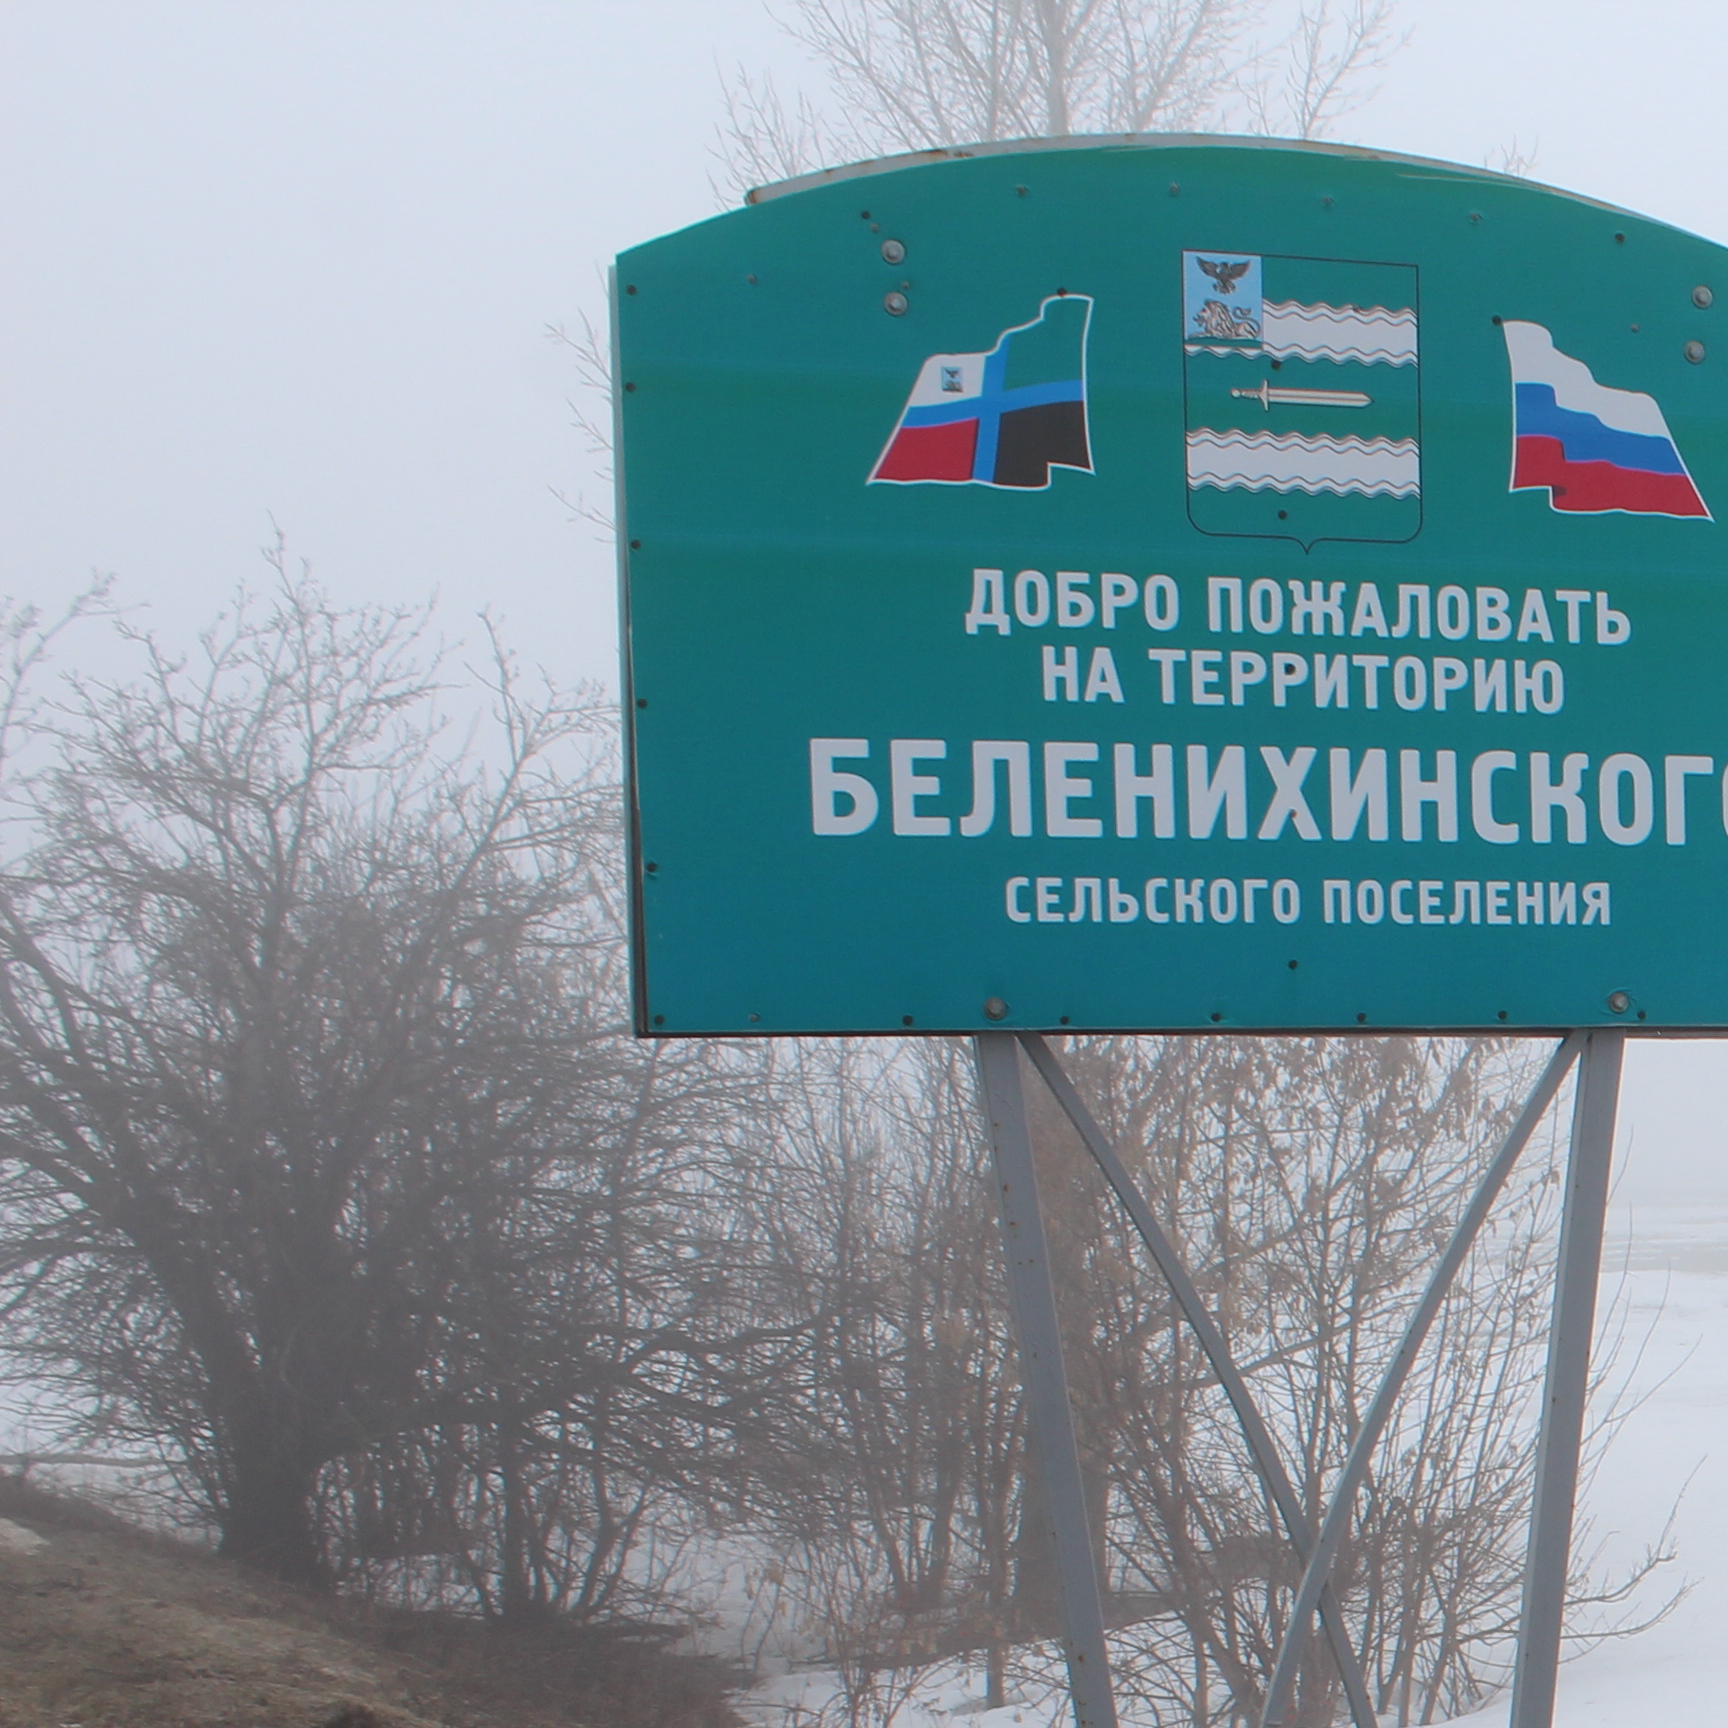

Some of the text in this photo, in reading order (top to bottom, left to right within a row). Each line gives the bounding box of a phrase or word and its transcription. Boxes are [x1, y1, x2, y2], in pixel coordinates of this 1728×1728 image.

[965, 568, 1630, 643] ДОБРО ПОЖАЛОВАТЬ
[1042, 645, 1563, 713] НА ТЕРРИТОРИЮ
[1006, 877, 1609, 924] СЕЛЬСКОГО ПОСЕЛЕНИЯ
